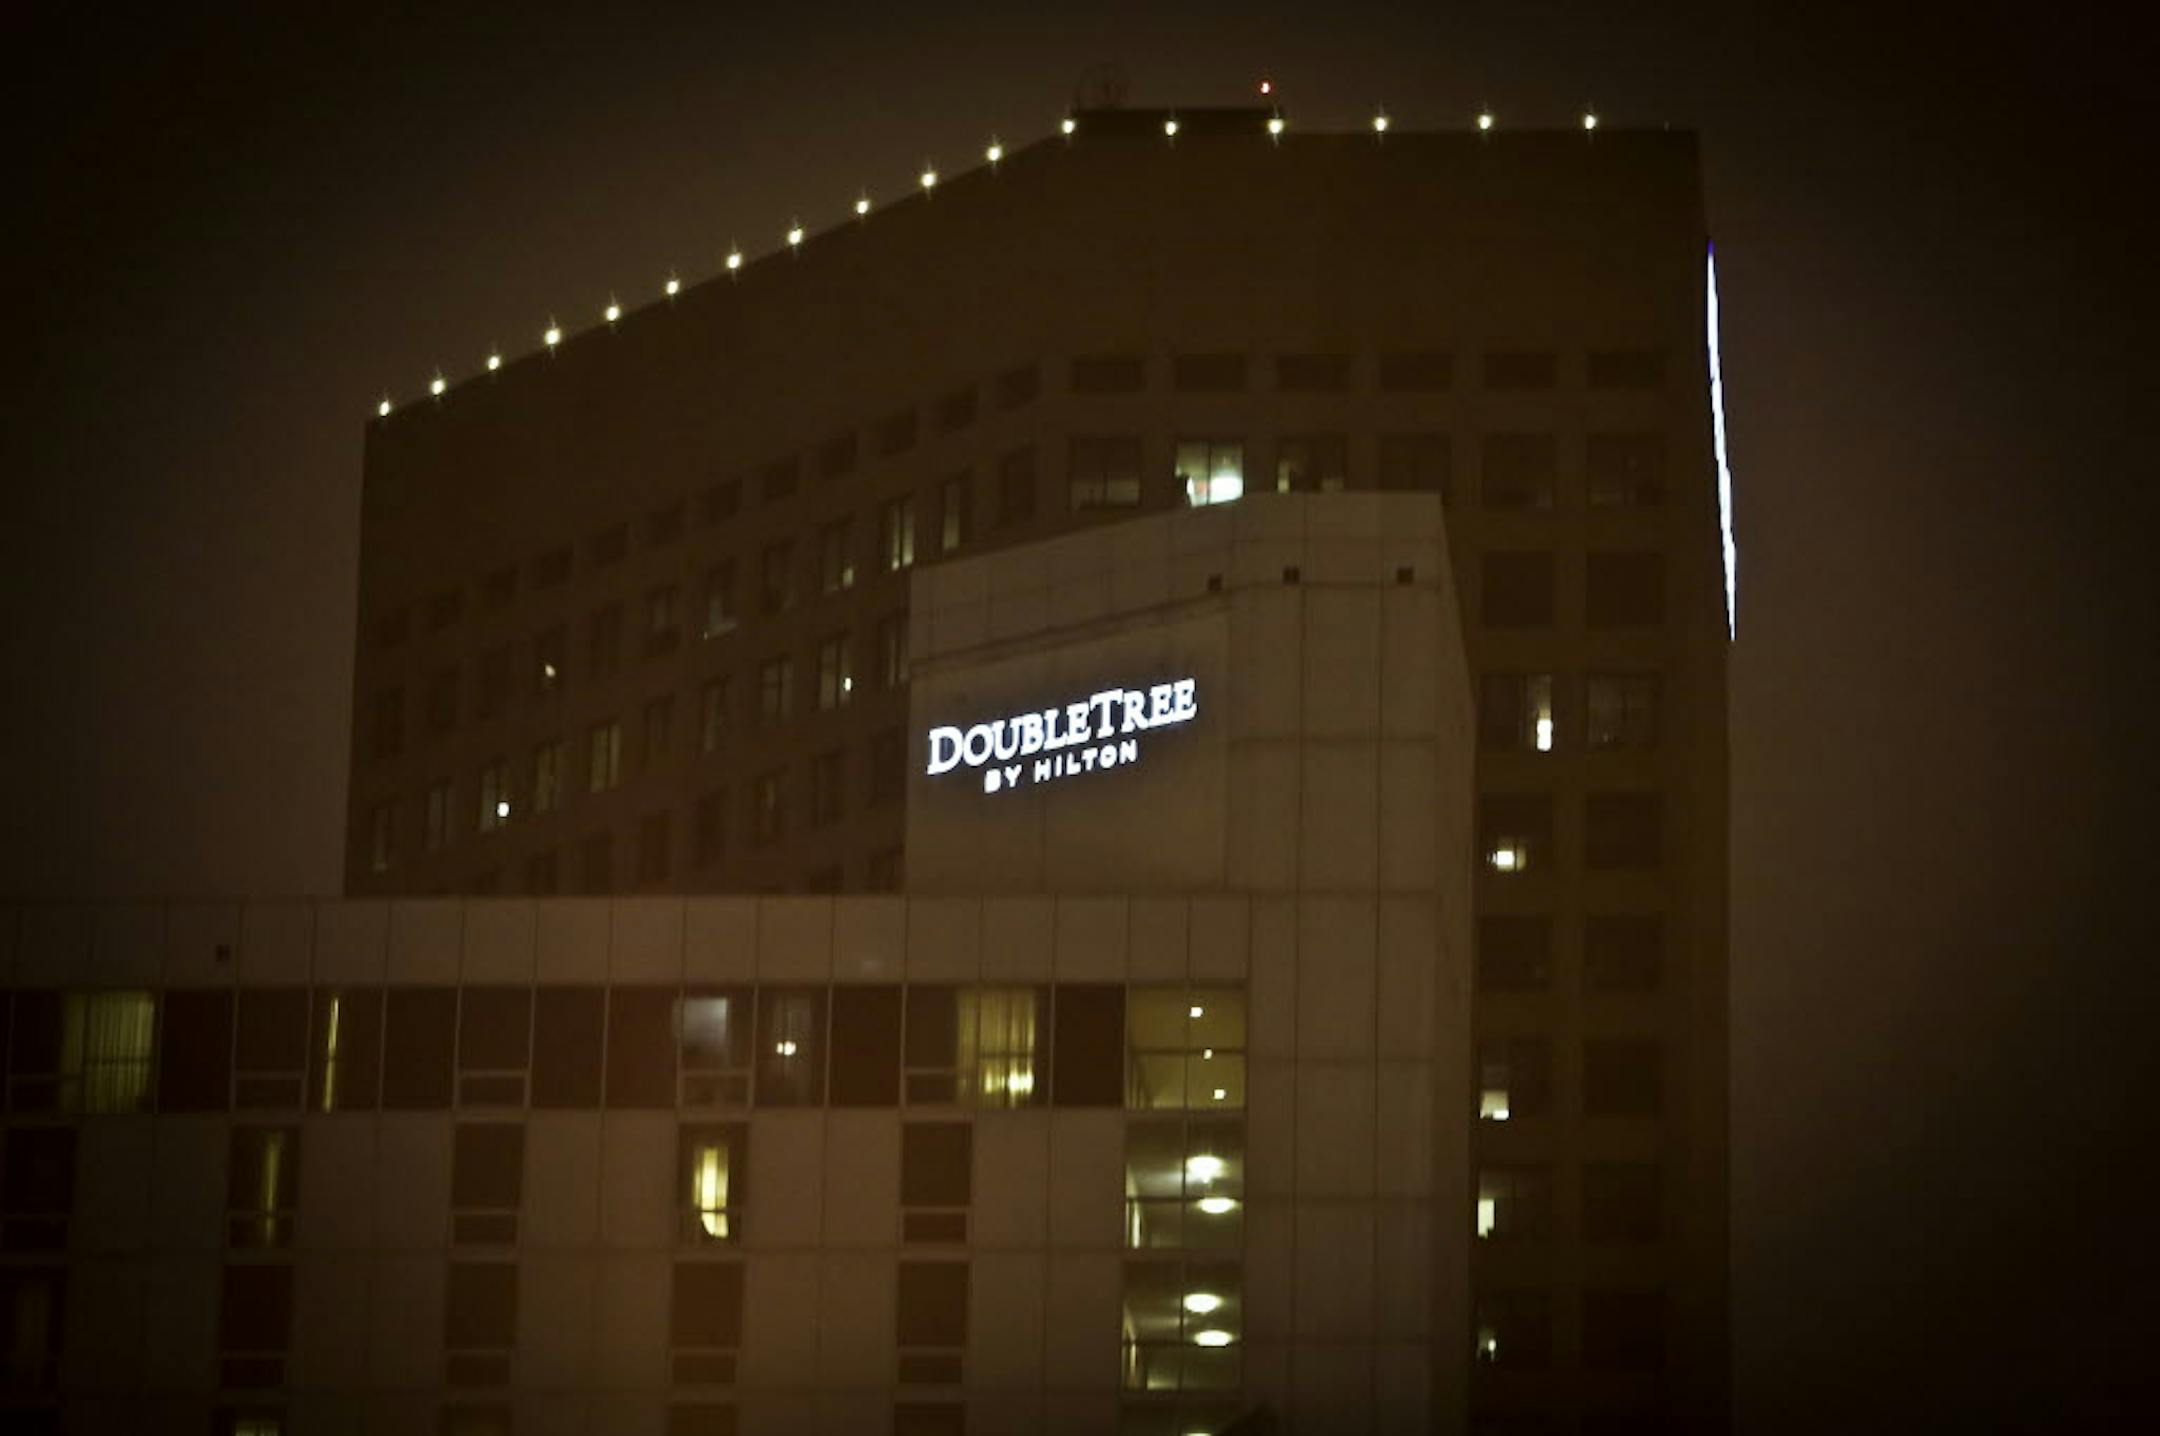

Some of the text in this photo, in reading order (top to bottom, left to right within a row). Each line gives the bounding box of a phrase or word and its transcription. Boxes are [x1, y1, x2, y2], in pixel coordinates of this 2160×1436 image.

[926, 678, 1197, 775] DOUBLETREE
[984, 739, 1138, 794] BY HILTON
